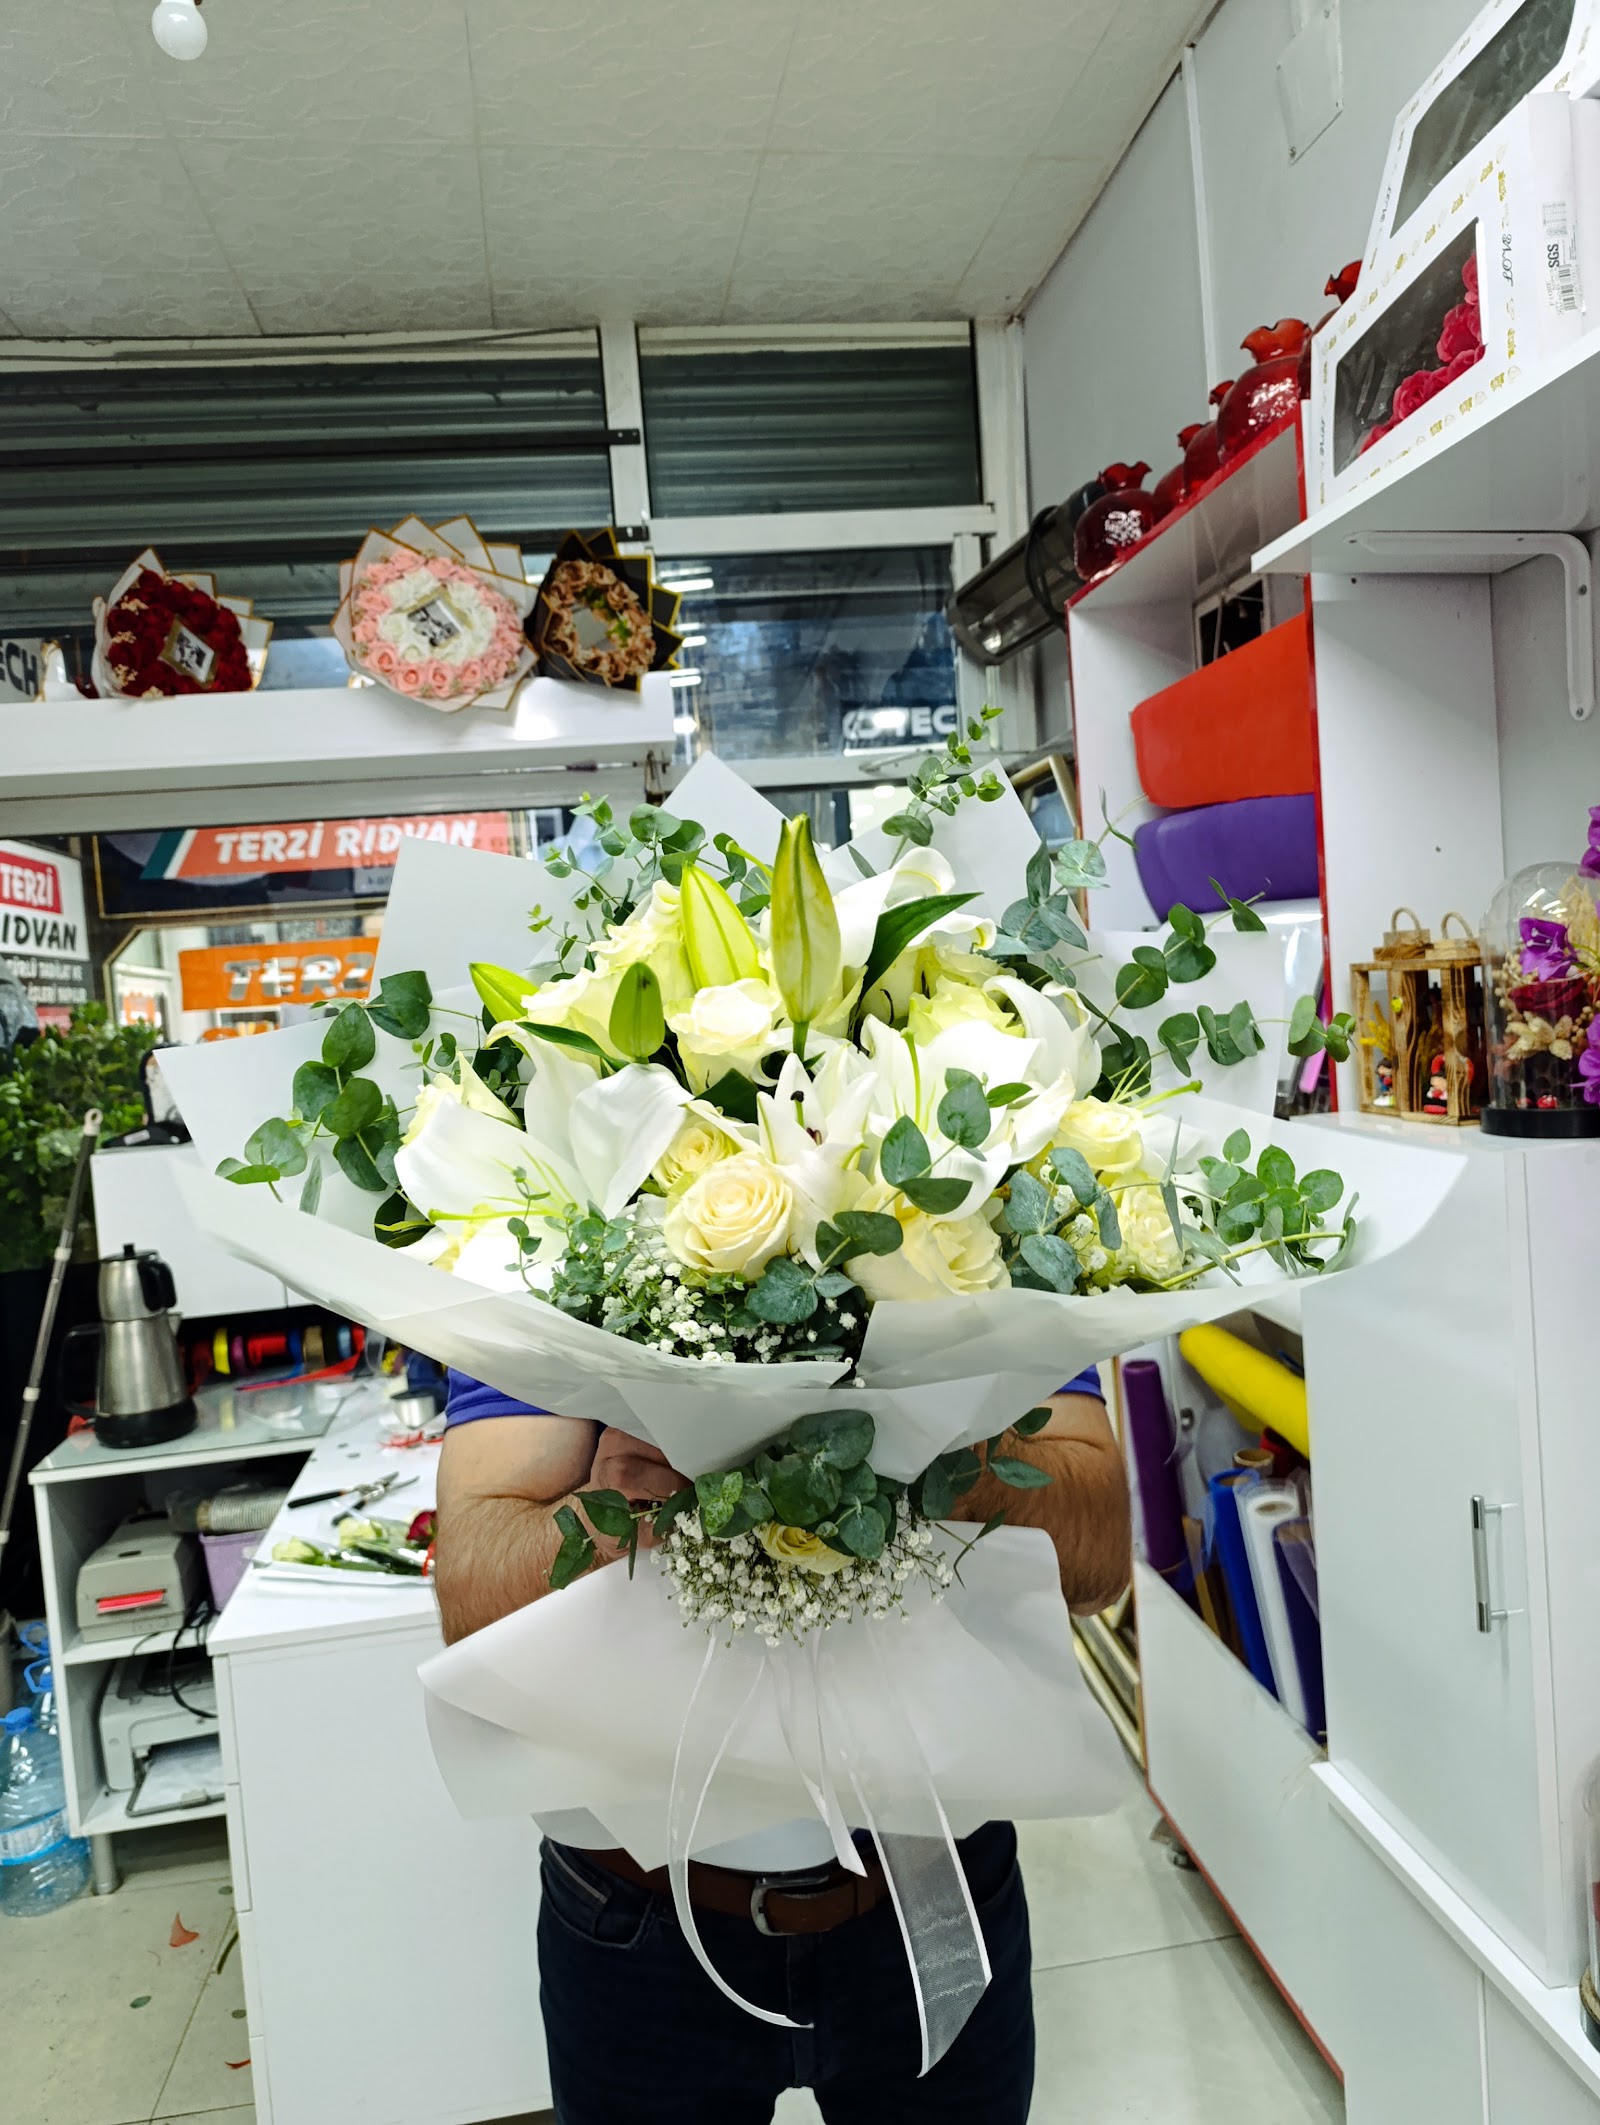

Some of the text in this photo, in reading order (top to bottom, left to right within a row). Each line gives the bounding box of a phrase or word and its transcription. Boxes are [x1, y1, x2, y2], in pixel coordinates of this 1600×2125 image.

[1547, 243, 1560, 268] SGS
[0, 641, 39, 697] CH
[214, 821, 325, 864] TERZİ
[0, 862, 53, 908] TERZİ
[2, 913, 76, 951] IDVAN
[223, 952, 374, 1000] TERZ
